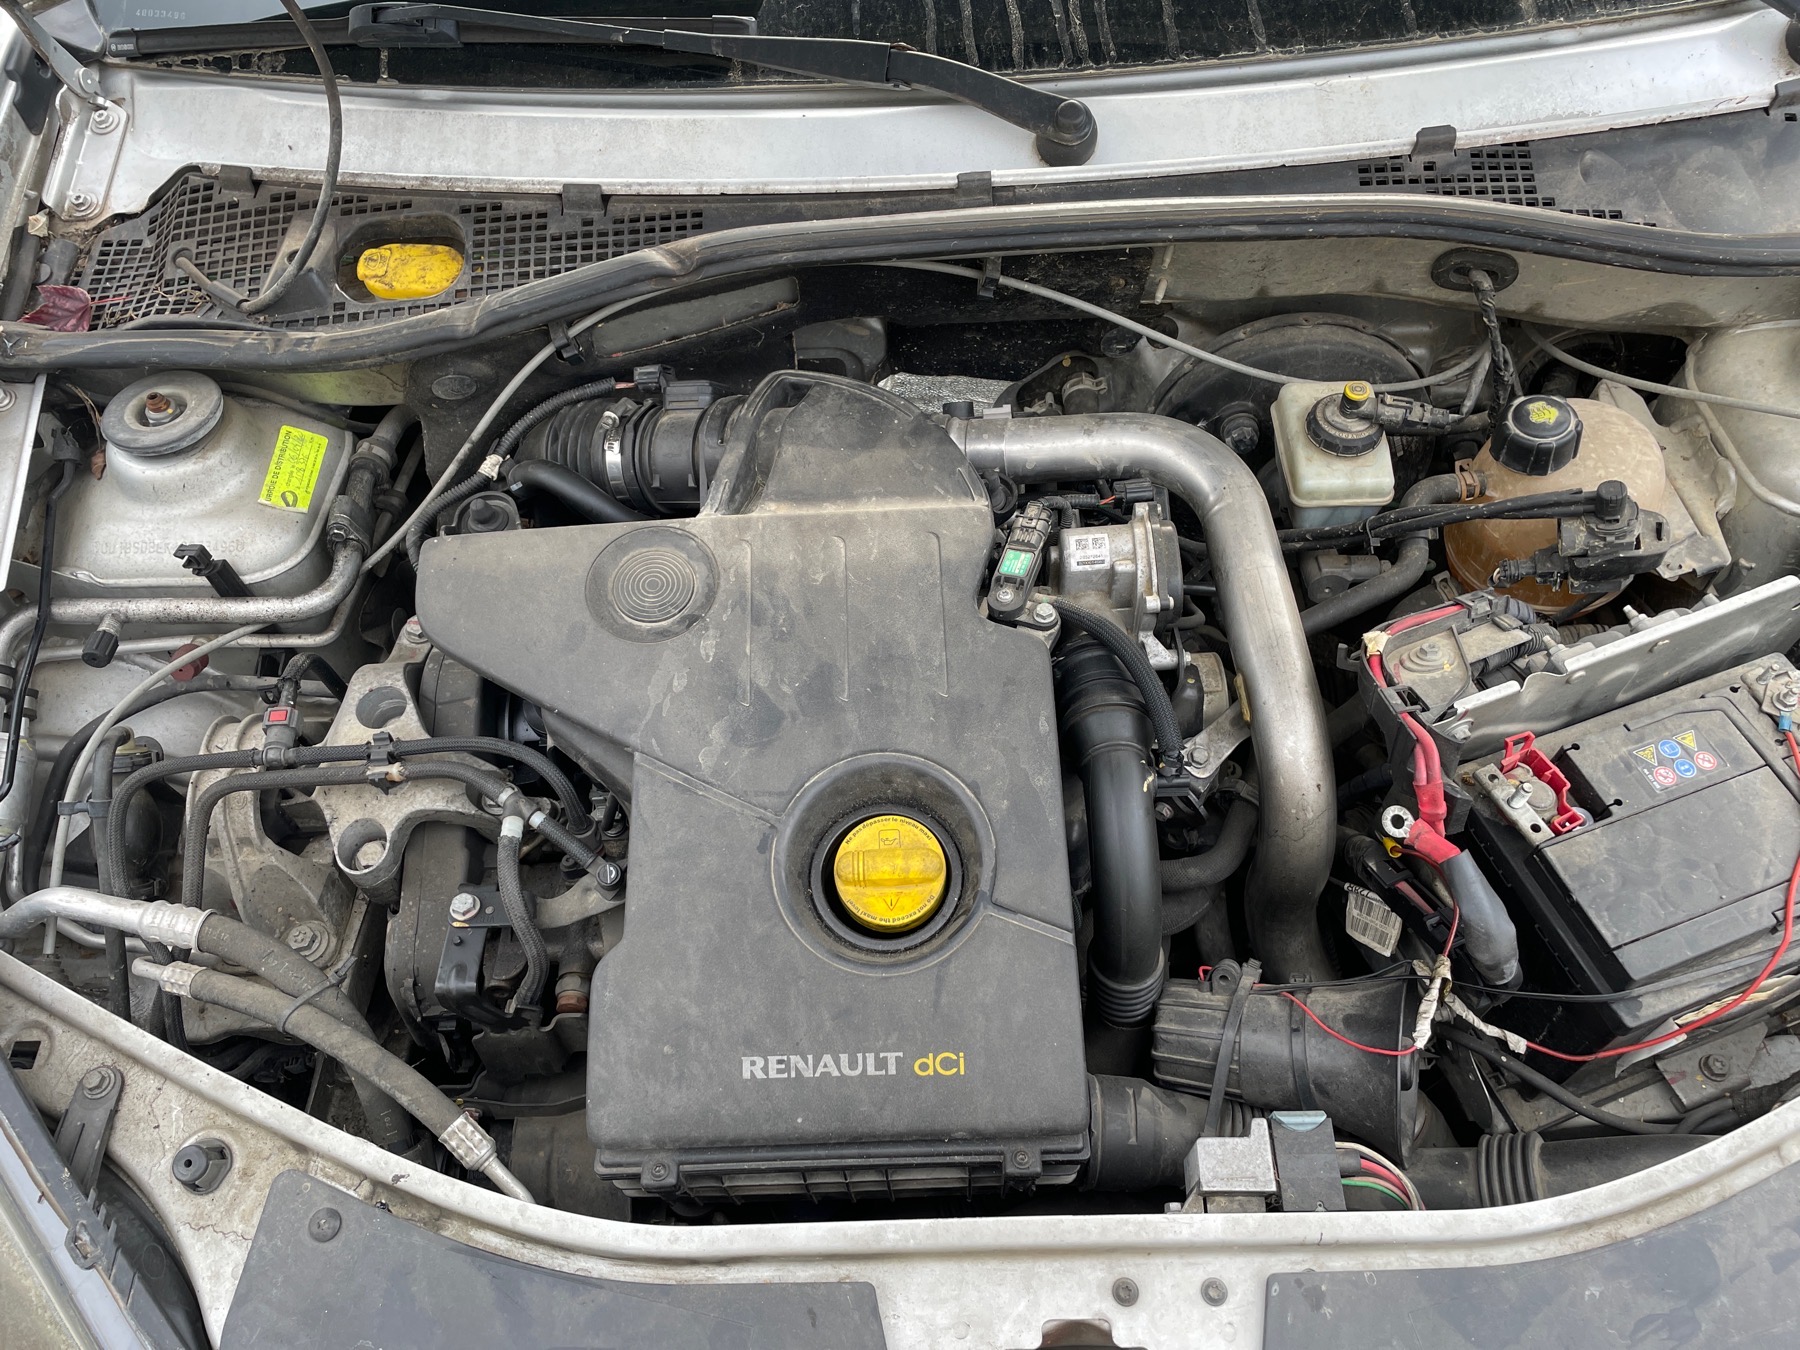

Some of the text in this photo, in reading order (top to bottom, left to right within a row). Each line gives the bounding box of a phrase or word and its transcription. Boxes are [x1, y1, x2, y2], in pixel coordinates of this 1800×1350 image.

[275, 430, 292, 471] DISTRIBUTION
[272, 471, 280, 480] DE
[845, 836, 853, 845] Ne
[852, 828, 863, 838] pas
[862, 817, 891, 829] dépasser
[899, 818, 920, 830] niveau
[919, 827, 933, 841] maxi
[846, 898, 861, 912] level
[926, 895, 936, 905] Do
[917, 903, 928, 914] not
[860, 910, 878, 921] maxi
[892, 911, 918, 923] exceed
[741, 1051, 965, 1080] RENAULT dCi
